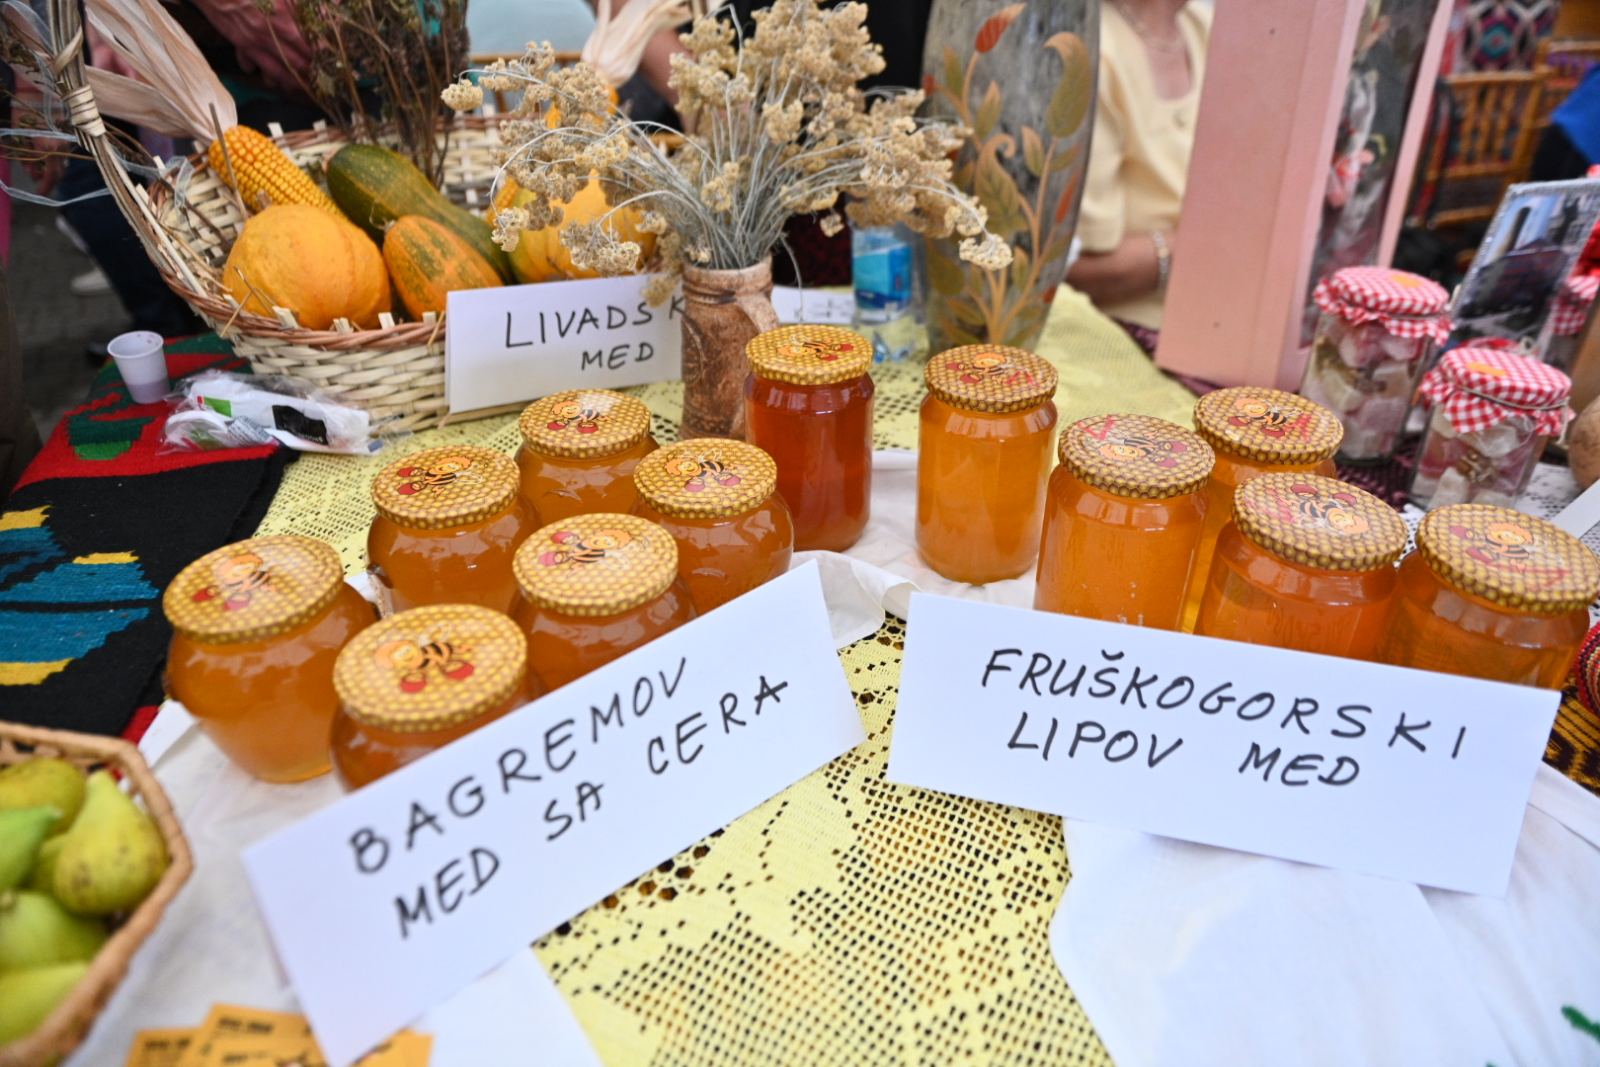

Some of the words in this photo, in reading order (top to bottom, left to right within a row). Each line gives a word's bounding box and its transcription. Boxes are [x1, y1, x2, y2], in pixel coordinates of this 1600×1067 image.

[581, 342, 655, 371] MED
[981, 648, 1467, 760] FRUŠKOGORSKI
[1007, 711, 1184, 768] LIPOV
[1238, 741, 1360, 787] MED
[349, 656, 687, 873] BAGREMOV
[394, 847, 500, 937] MED
[544, 781, 604, 842] SA
[647, 675, 789, 775] CERA
